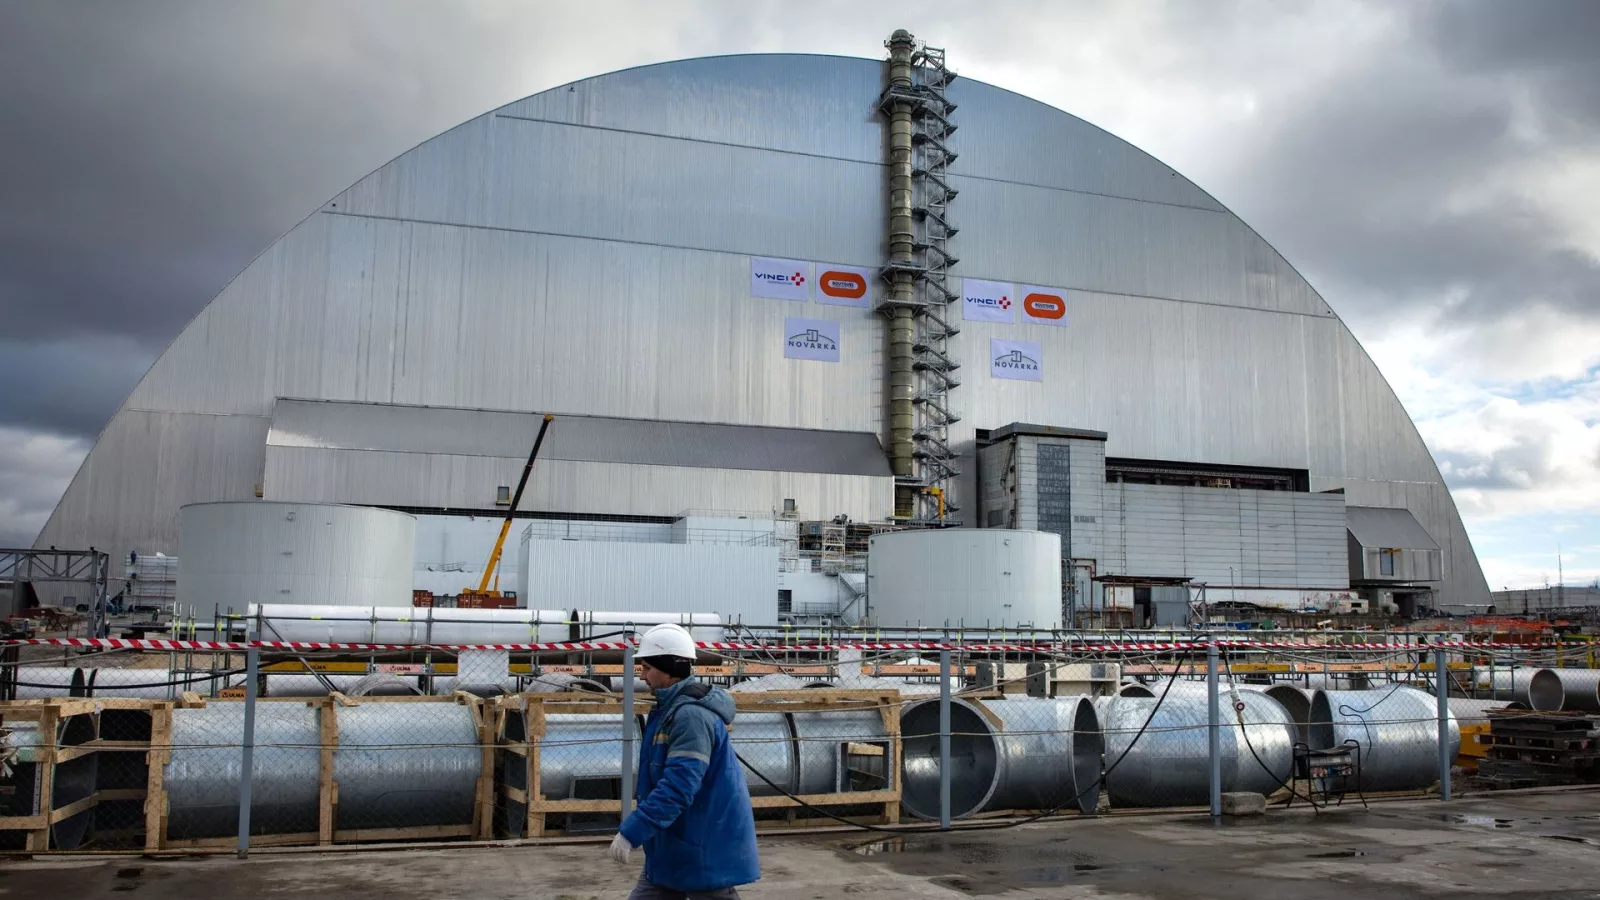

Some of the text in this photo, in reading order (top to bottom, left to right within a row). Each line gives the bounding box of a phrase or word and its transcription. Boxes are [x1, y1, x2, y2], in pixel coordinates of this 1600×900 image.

[755, 272, 789, 281] VINCI
[966, 297, 997, 305] VINCI
[788, 340, 836, 350] NOVARKA
[994, 361, 1038, 370] NOVARKA
